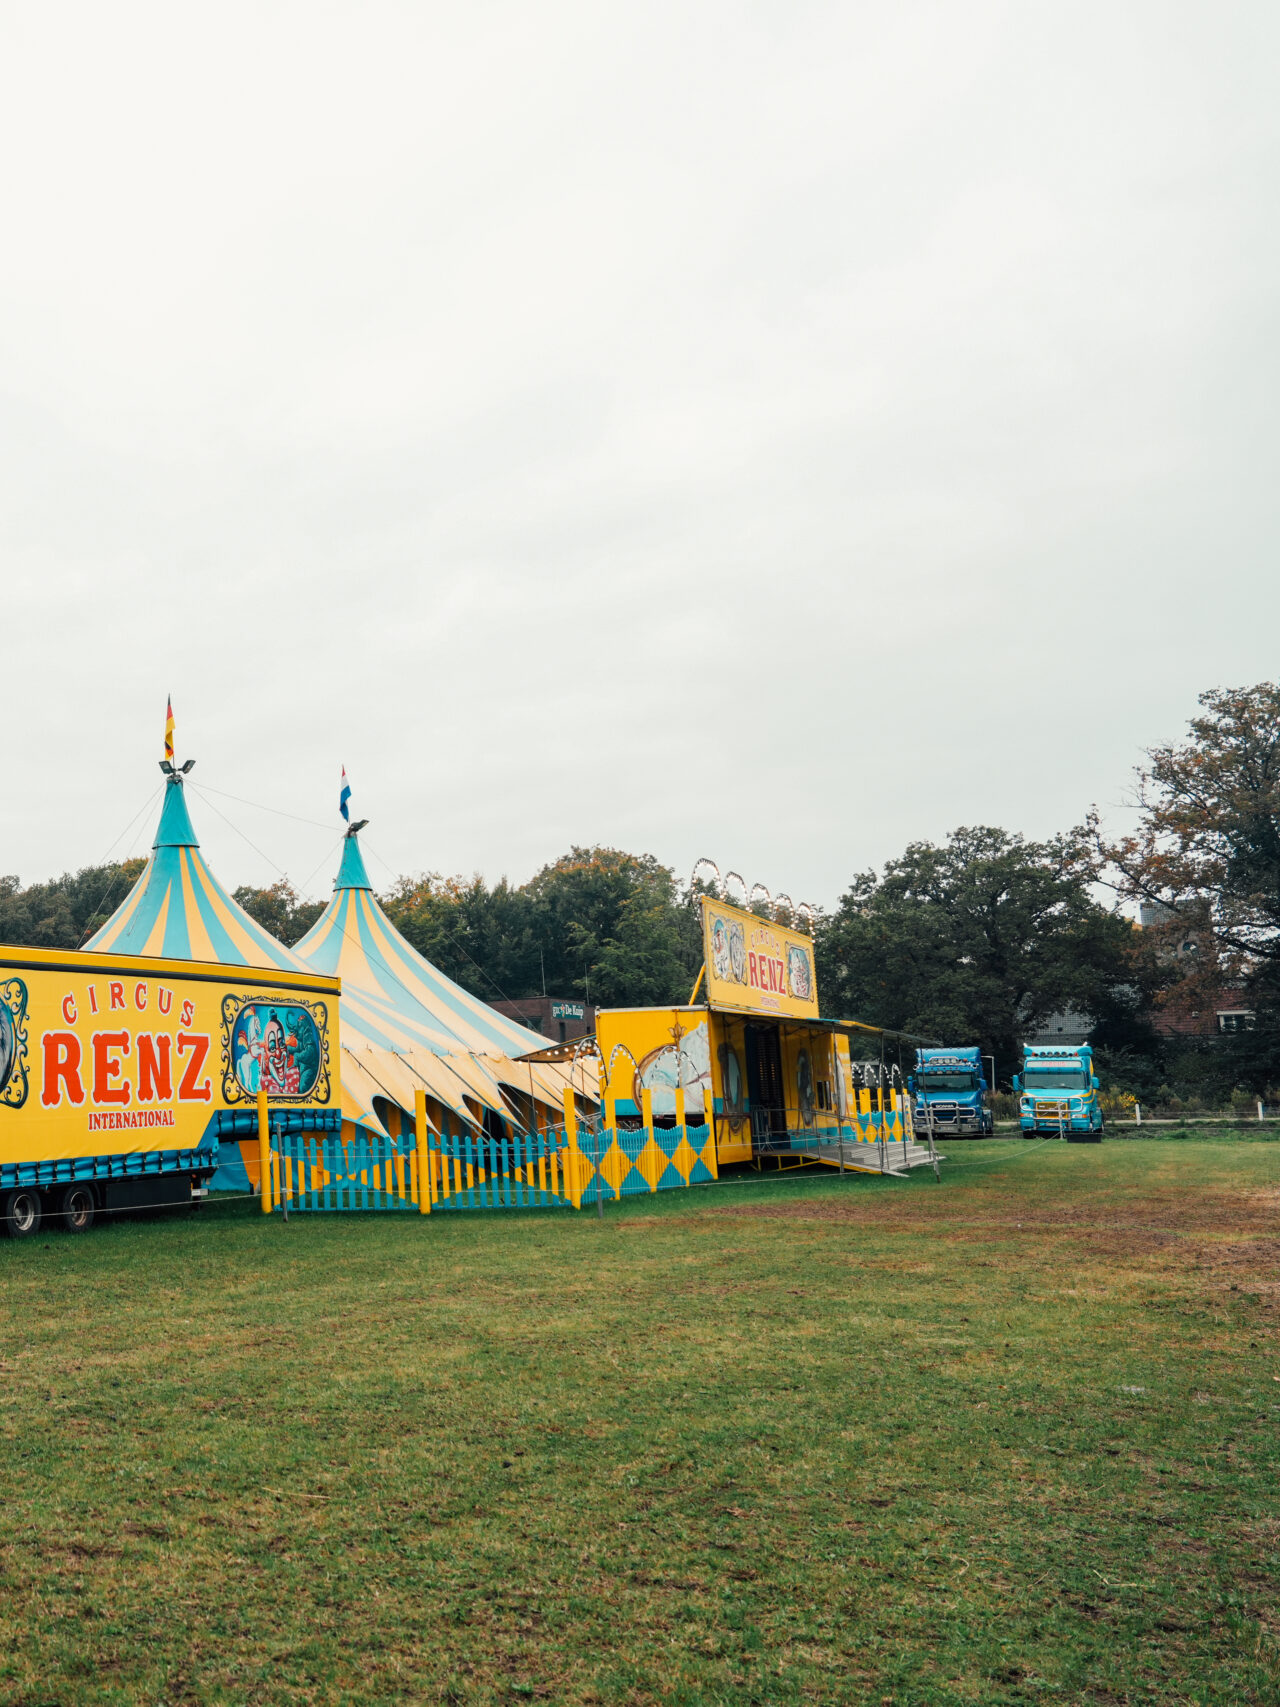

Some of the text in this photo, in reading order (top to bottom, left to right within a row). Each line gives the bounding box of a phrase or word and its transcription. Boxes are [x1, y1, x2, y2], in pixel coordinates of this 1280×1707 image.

[748, 950, 787, 996] RENZ
[61, 980, 195, 1028] CIRCUS
[40, 1029, 212, 1108] RENZ
[87, 1109, 175, 1131] INTERNATIONAL
